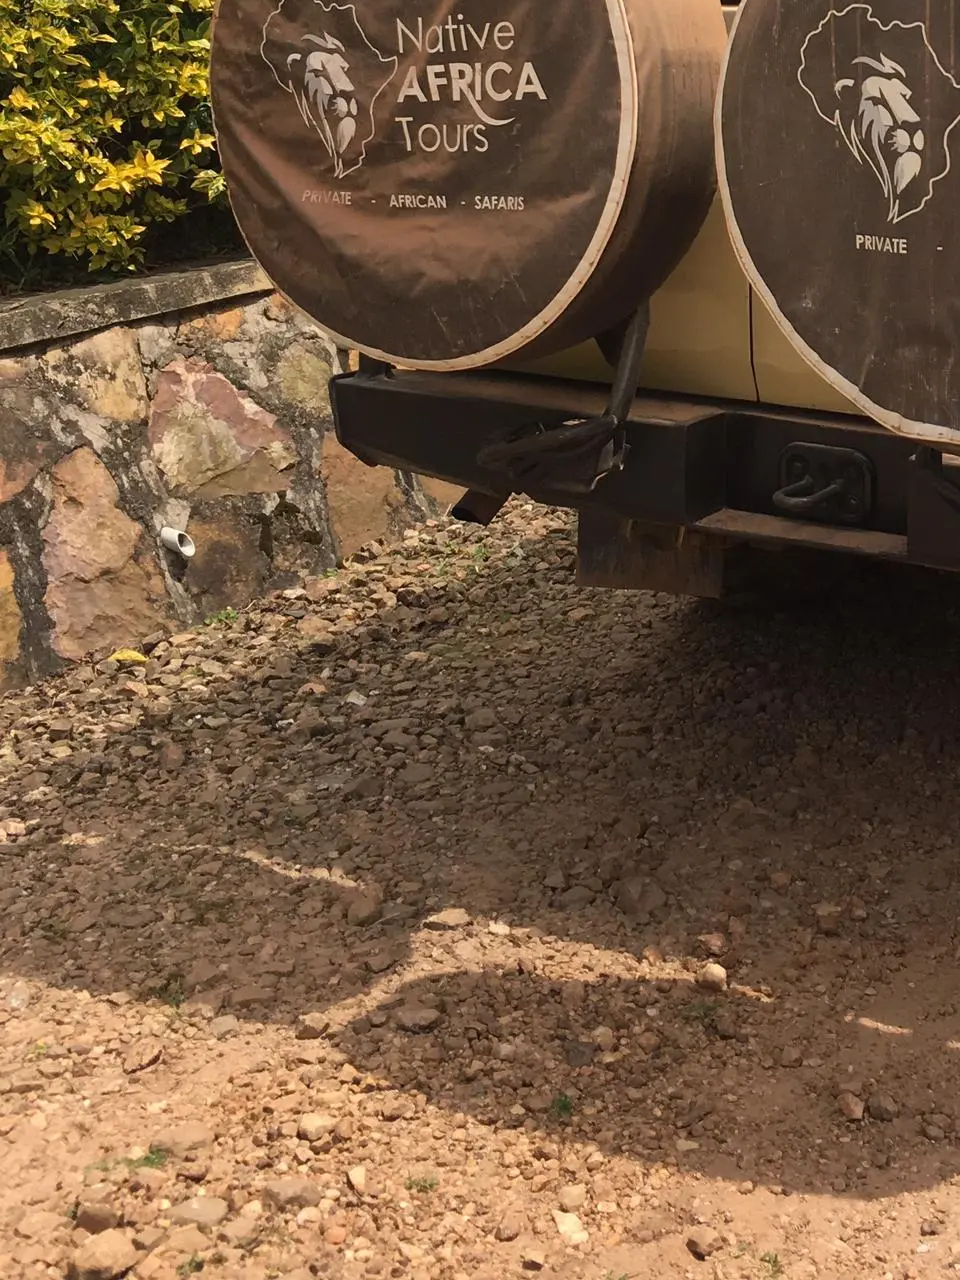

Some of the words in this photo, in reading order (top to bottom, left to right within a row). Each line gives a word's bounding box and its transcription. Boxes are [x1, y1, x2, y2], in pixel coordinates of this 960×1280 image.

[396, 13, 515, 54] Native
[396, 61, 547, 125] AFRICA
[395, 116, 489, 153] Tours
[301, 189, 352, 205] PRIVATE
[389, 194, 447, 209] AFRICAN
[474, 195, 525, 210] SAFARIS
[855, 234, 908, 254] PRIVATE
